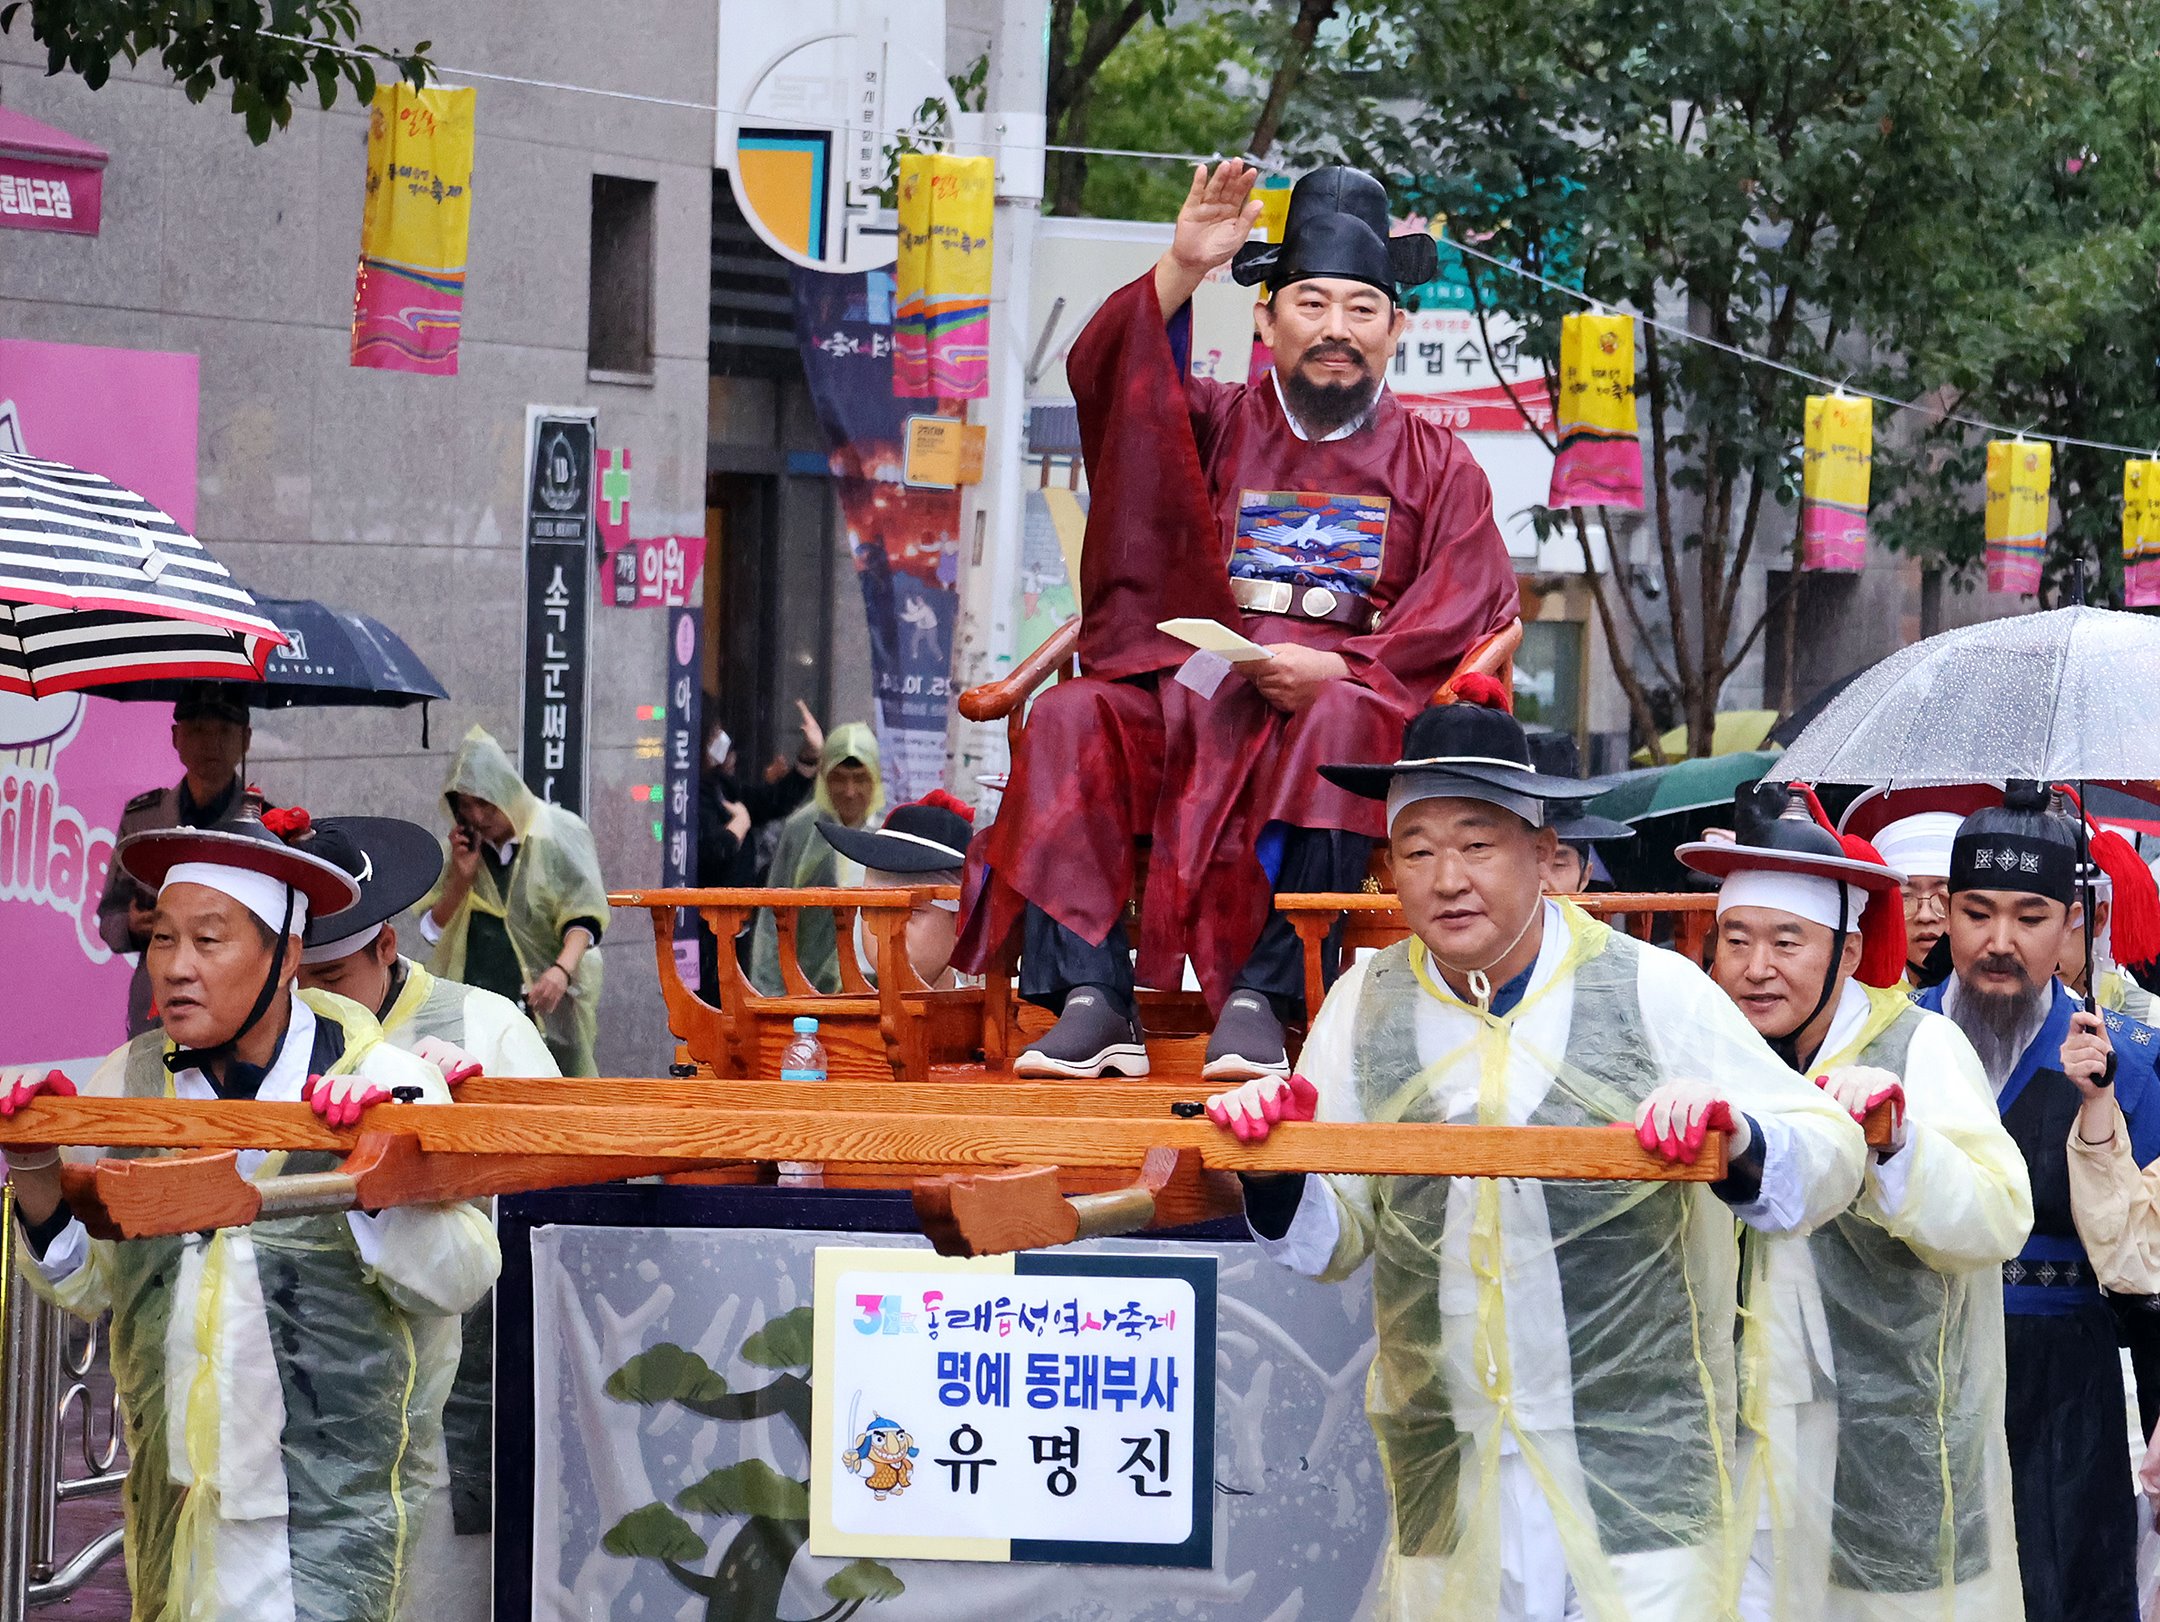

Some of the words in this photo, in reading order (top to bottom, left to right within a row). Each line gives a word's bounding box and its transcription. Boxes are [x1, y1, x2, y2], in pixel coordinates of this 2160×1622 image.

[641, 537, 685, 607] 의원
[937, 1351, 1011, 1408] 명예
[1025, 1353, 1179, 1413] 동래부사
